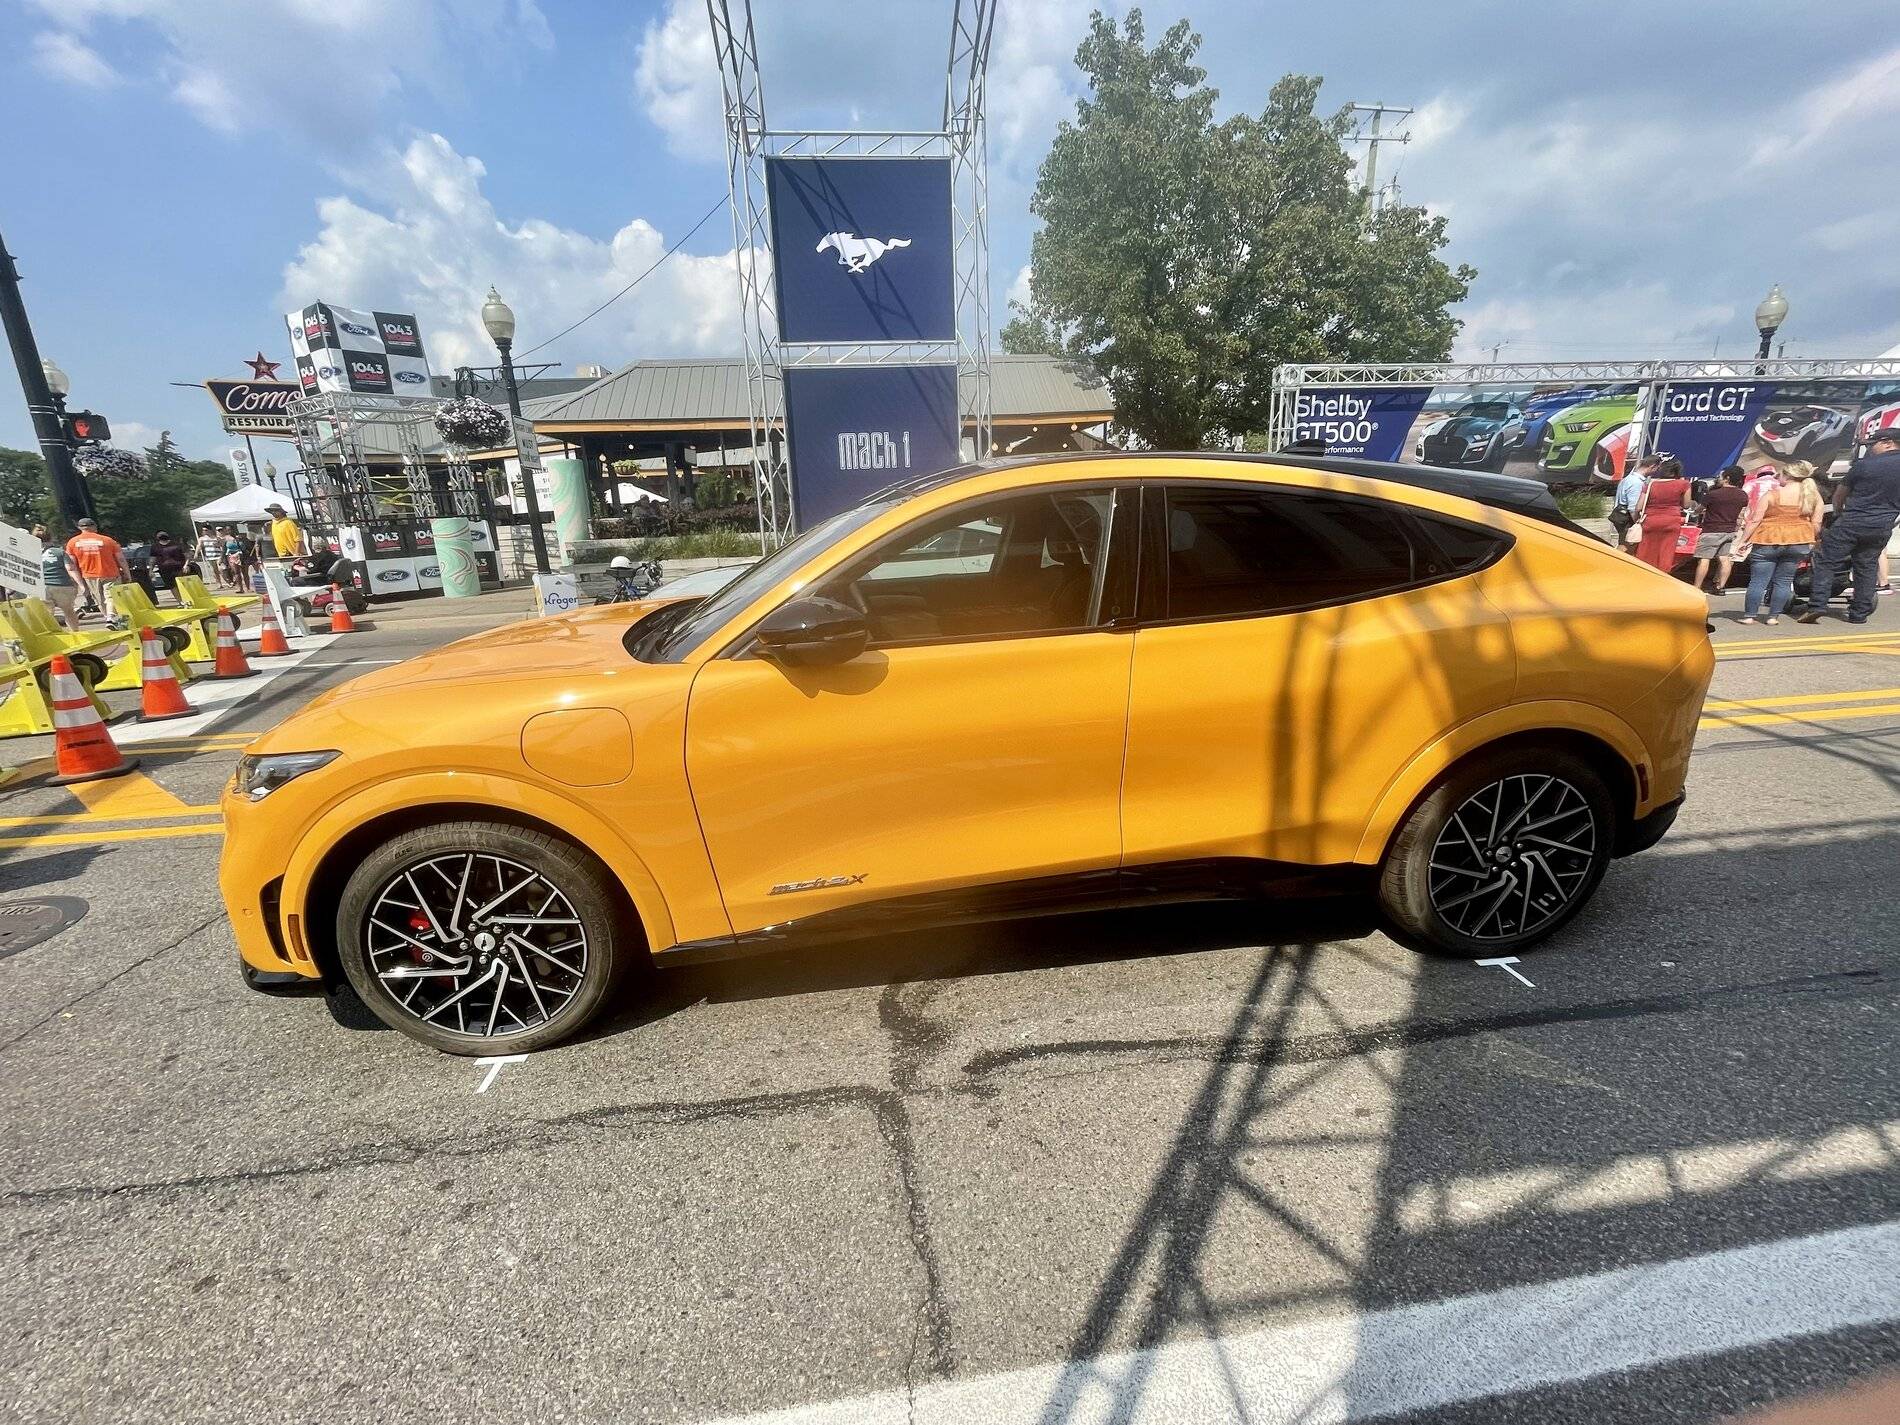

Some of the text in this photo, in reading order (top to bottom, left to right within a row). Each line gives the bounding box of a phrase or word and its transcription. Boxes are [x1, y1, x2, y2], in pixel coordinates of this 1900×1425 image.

[383, 323, 413, 336] 104.3
[351, 362, 384, 375] 104.3
[1717, 387, 1755, 411] GT
[1298, 394, 1372, 420] Shelby
[227, 417, 295, 428] RESTAURA
[1653, 414, 1745, 422] erformance and Technology
[902, 431, 911, 467] 1
[1324, 446, 1365, 454] erformance
[372, 531, 399, 542] 104.3
[544, 592, 577, 610] Kroger
